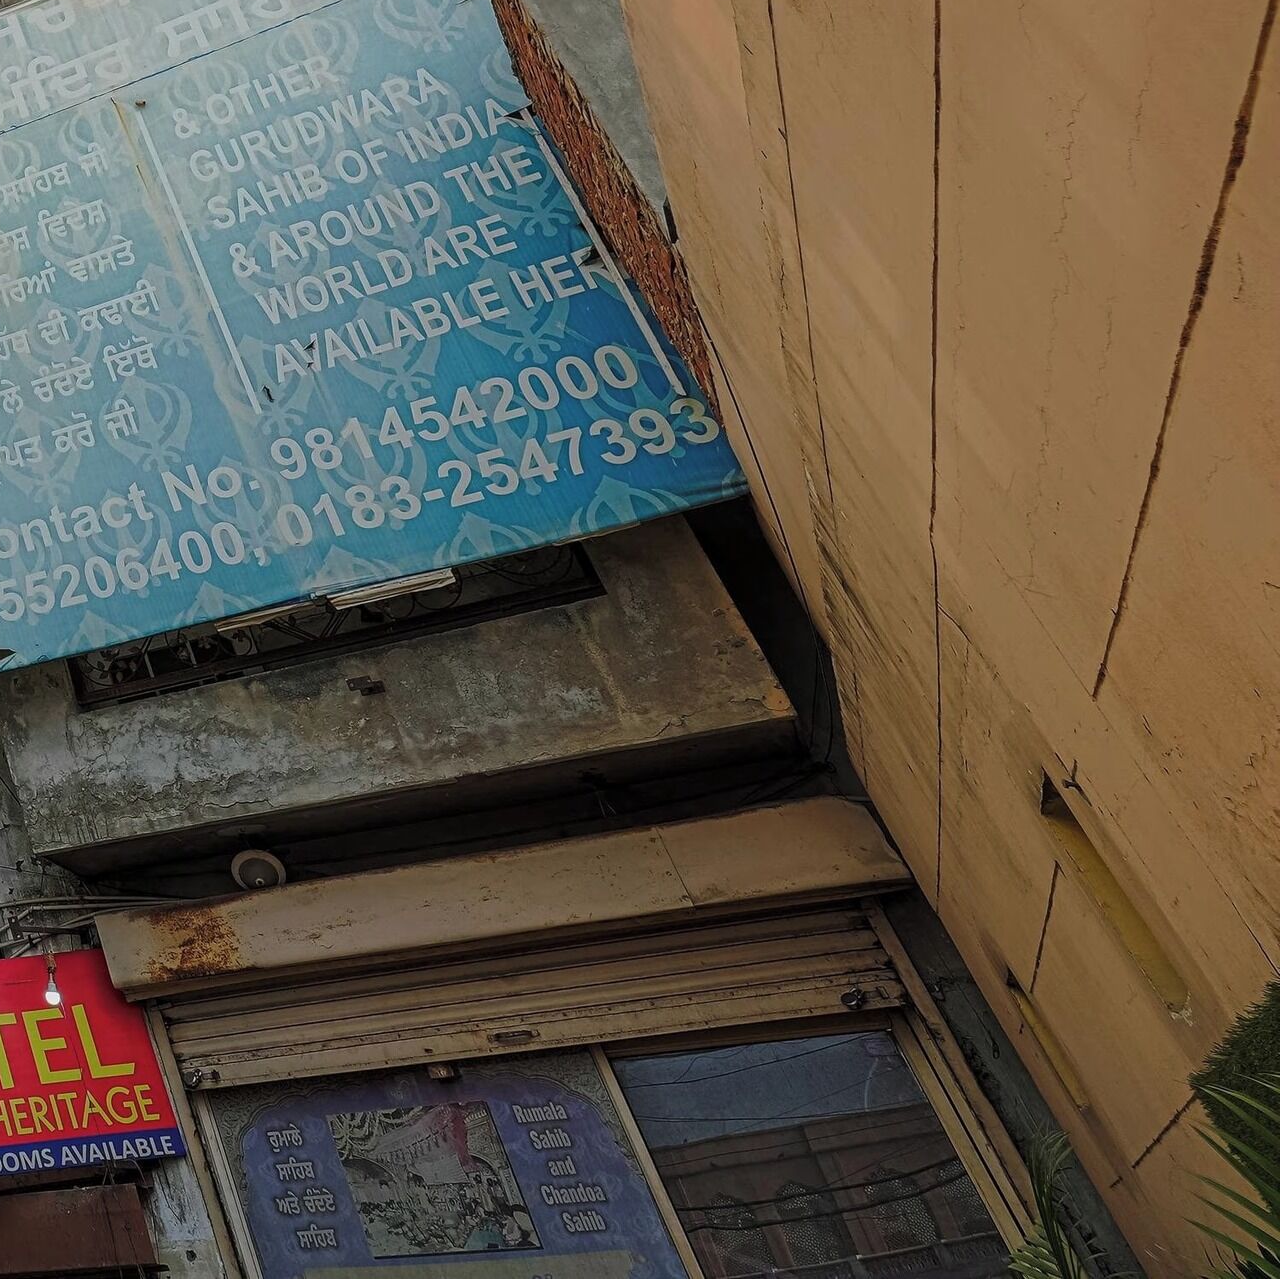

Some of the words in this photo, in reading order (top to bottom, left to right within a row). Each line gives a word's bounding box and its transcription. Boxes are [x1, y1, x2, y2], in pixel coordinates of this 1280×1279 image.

[174, 108, 201, 138] &
[206, 55, 335, 127] OTHER
[188, 66, 449, 182] GURUDWARA
[207, 164, 326, 230] SAHIB
[339, 141, 389, 184] OF
[403, 97, 520, 162] INDIA
[228, 241, 259, 279] &
[267, 180, 439, 268] AROUND
[444, 145, 542, 204] THE
[254, 248, 413, 326] WORLD
[425, 213, 518, 276] ARE
[274, 277, 510, 383] AVAILABLE
[161, 461, 259, 513] No.
[269, 345, 639, 481] 9814542000
[278, 396, 721, 548] 0183-2547393
[60, 1135, 176, 1167] AVAILABLE
[512, 1101, 568, 1124] Rumala
[529, 1128, 572, 1151] Sahib
[540, 1182, 607, 1206] Chandoa
[548, 1155, 577, 1177] and
[562, 1210, 607, 1233] Sahib
